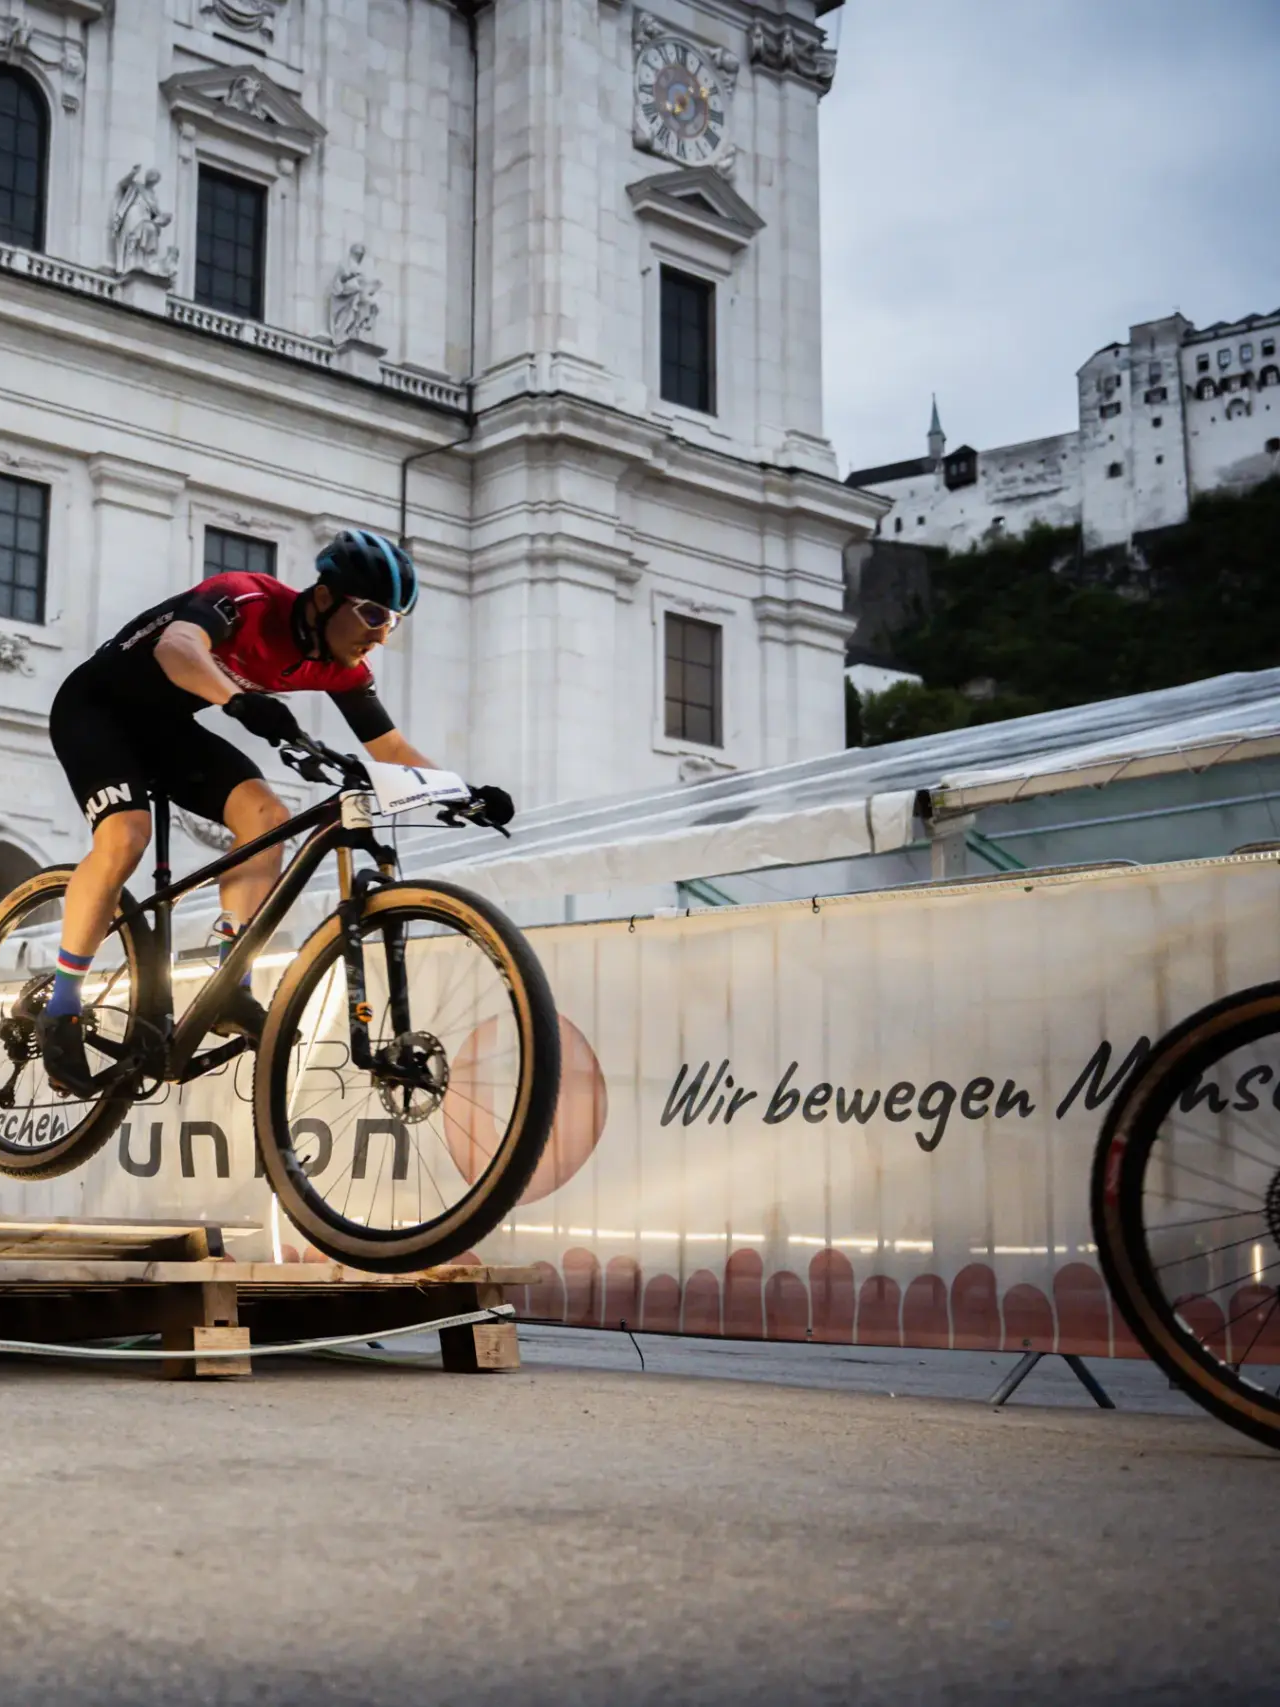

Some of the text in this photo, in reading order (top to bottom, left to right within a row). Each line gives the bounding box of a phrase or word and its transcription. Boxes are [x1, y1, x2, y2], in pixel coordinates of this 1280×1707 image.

[660, 1036, 1280, 1152] Wir bewegen Mns
[118, 1117, 410, 1180] unon
